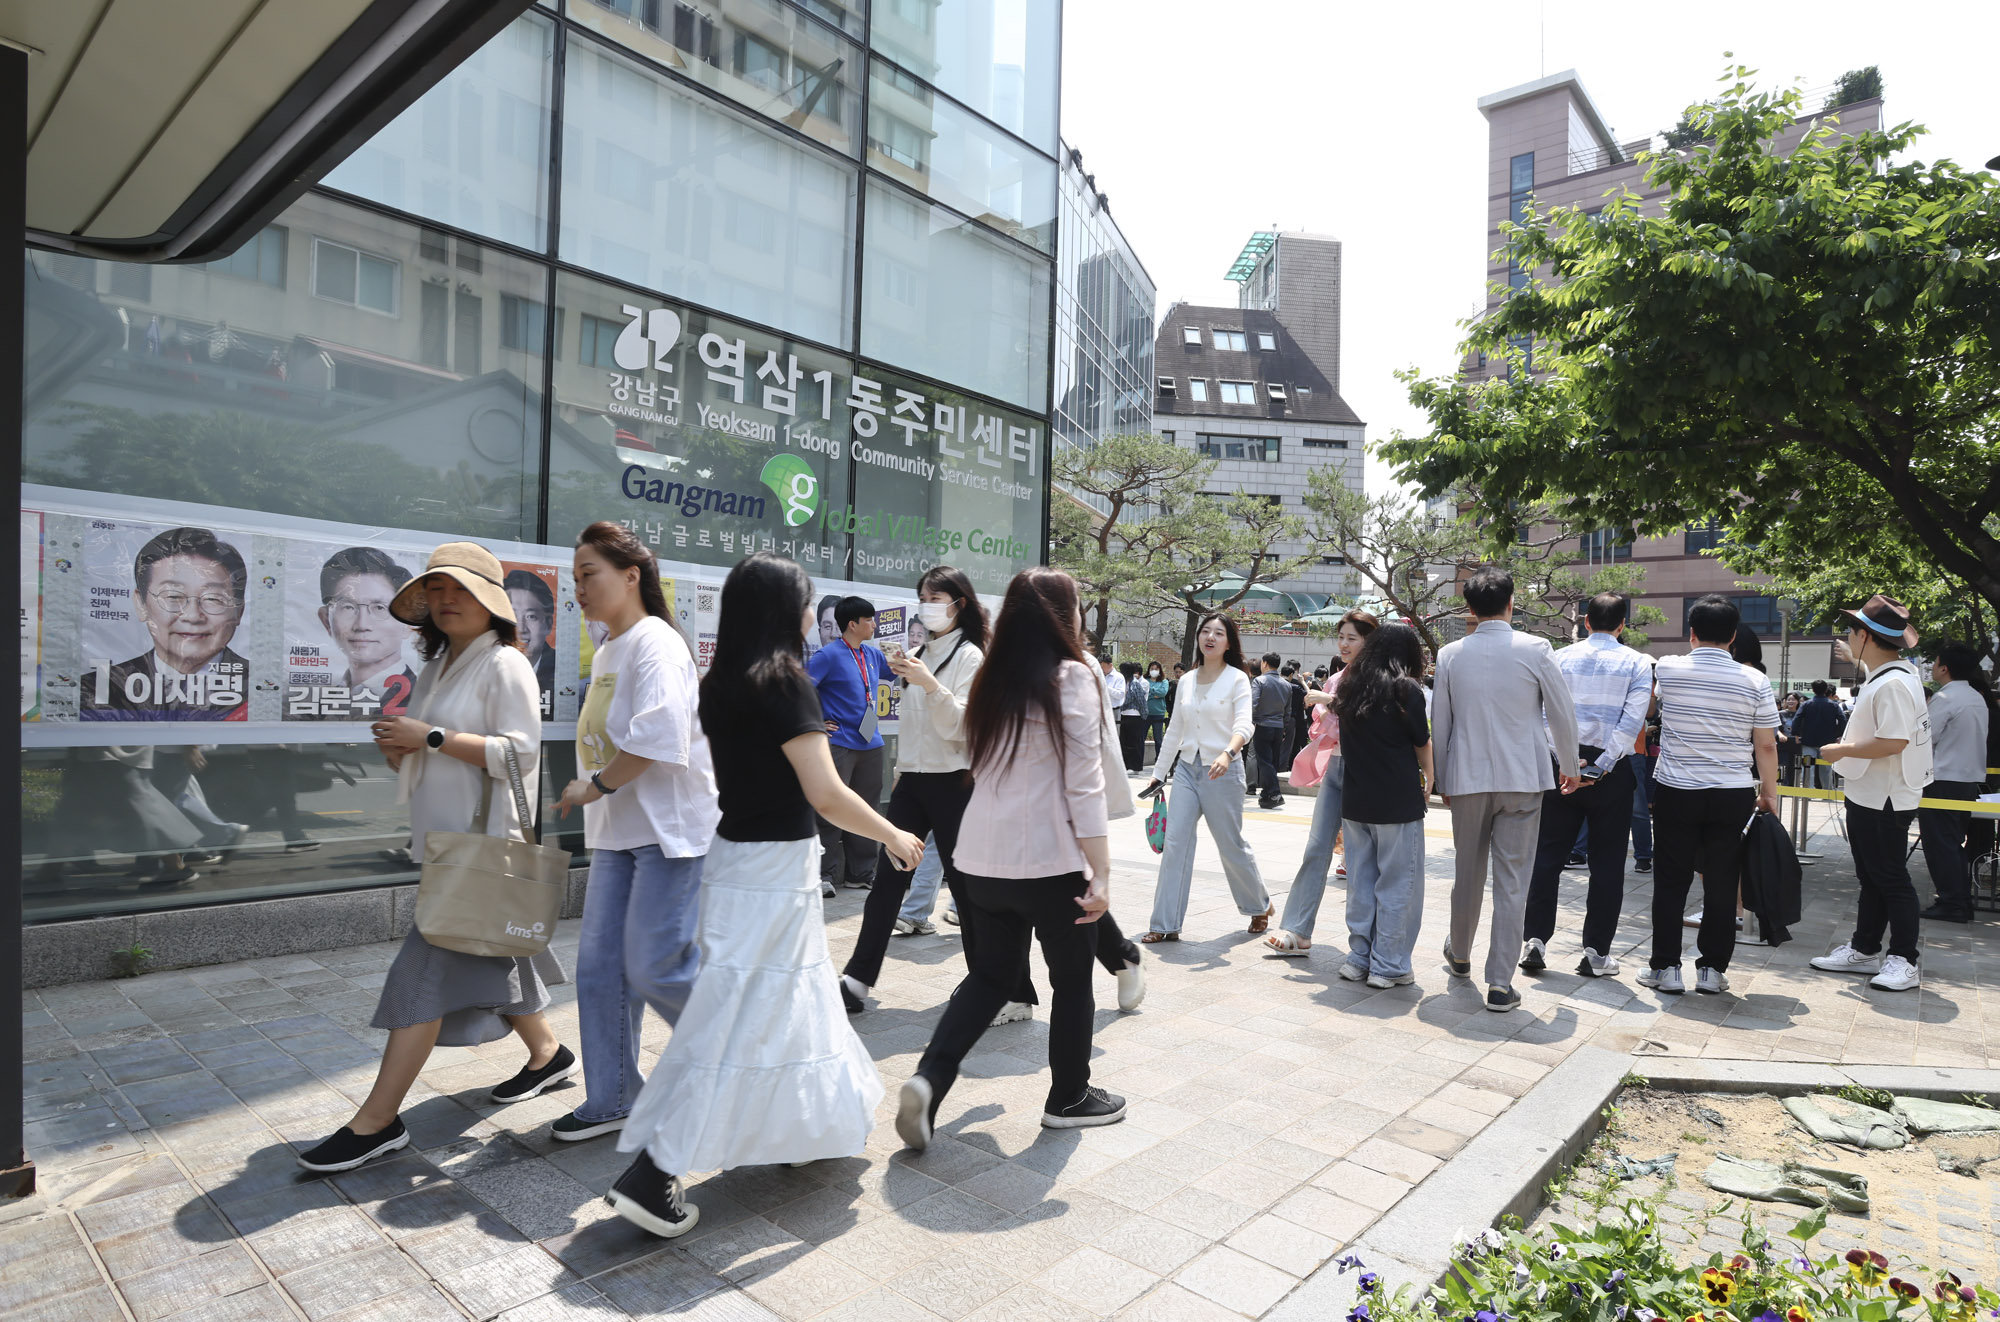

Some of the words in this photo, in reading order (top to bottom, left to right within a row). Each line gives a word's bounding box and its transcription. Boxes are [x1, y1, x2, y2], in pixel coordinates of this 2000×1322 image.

[609, 372, 681, 411] 강남구
[698, 332, 1036, 477] 역삼1동주민센터
[696, 402, 776, 442] Yeoksam
[783, 423, 841, 460] 1-dong
[851, 440, 935, 481] Community
[939, 462, 988, 491] Service
[991, 475, 1033, 501] Center
[621, 464, 766, 519] Gangnam
[887, 512, 963, 555] Village
[967, 528, 1032, 561] Center
[856, 549, 915, 573] Support
[90, 587, 130, 598] 이제부터
[90, 598, 111, 608] 진짜
[90, 610, 130, 621] 대한민국
[290, 646, 320, 656] 새롭게
[208, 662, 244, 673] 지금은
[289, 656, 329, 667] 대한민국
[89, 658, 112, 705] 1
[124, 672, 244, 706] 이재명
[291, 673, 330, 684] 정정당당
[288, 686, 381, 716] 김문수
[382, 674, 412, 716] 2
[505, 920, 532, 939] kms
